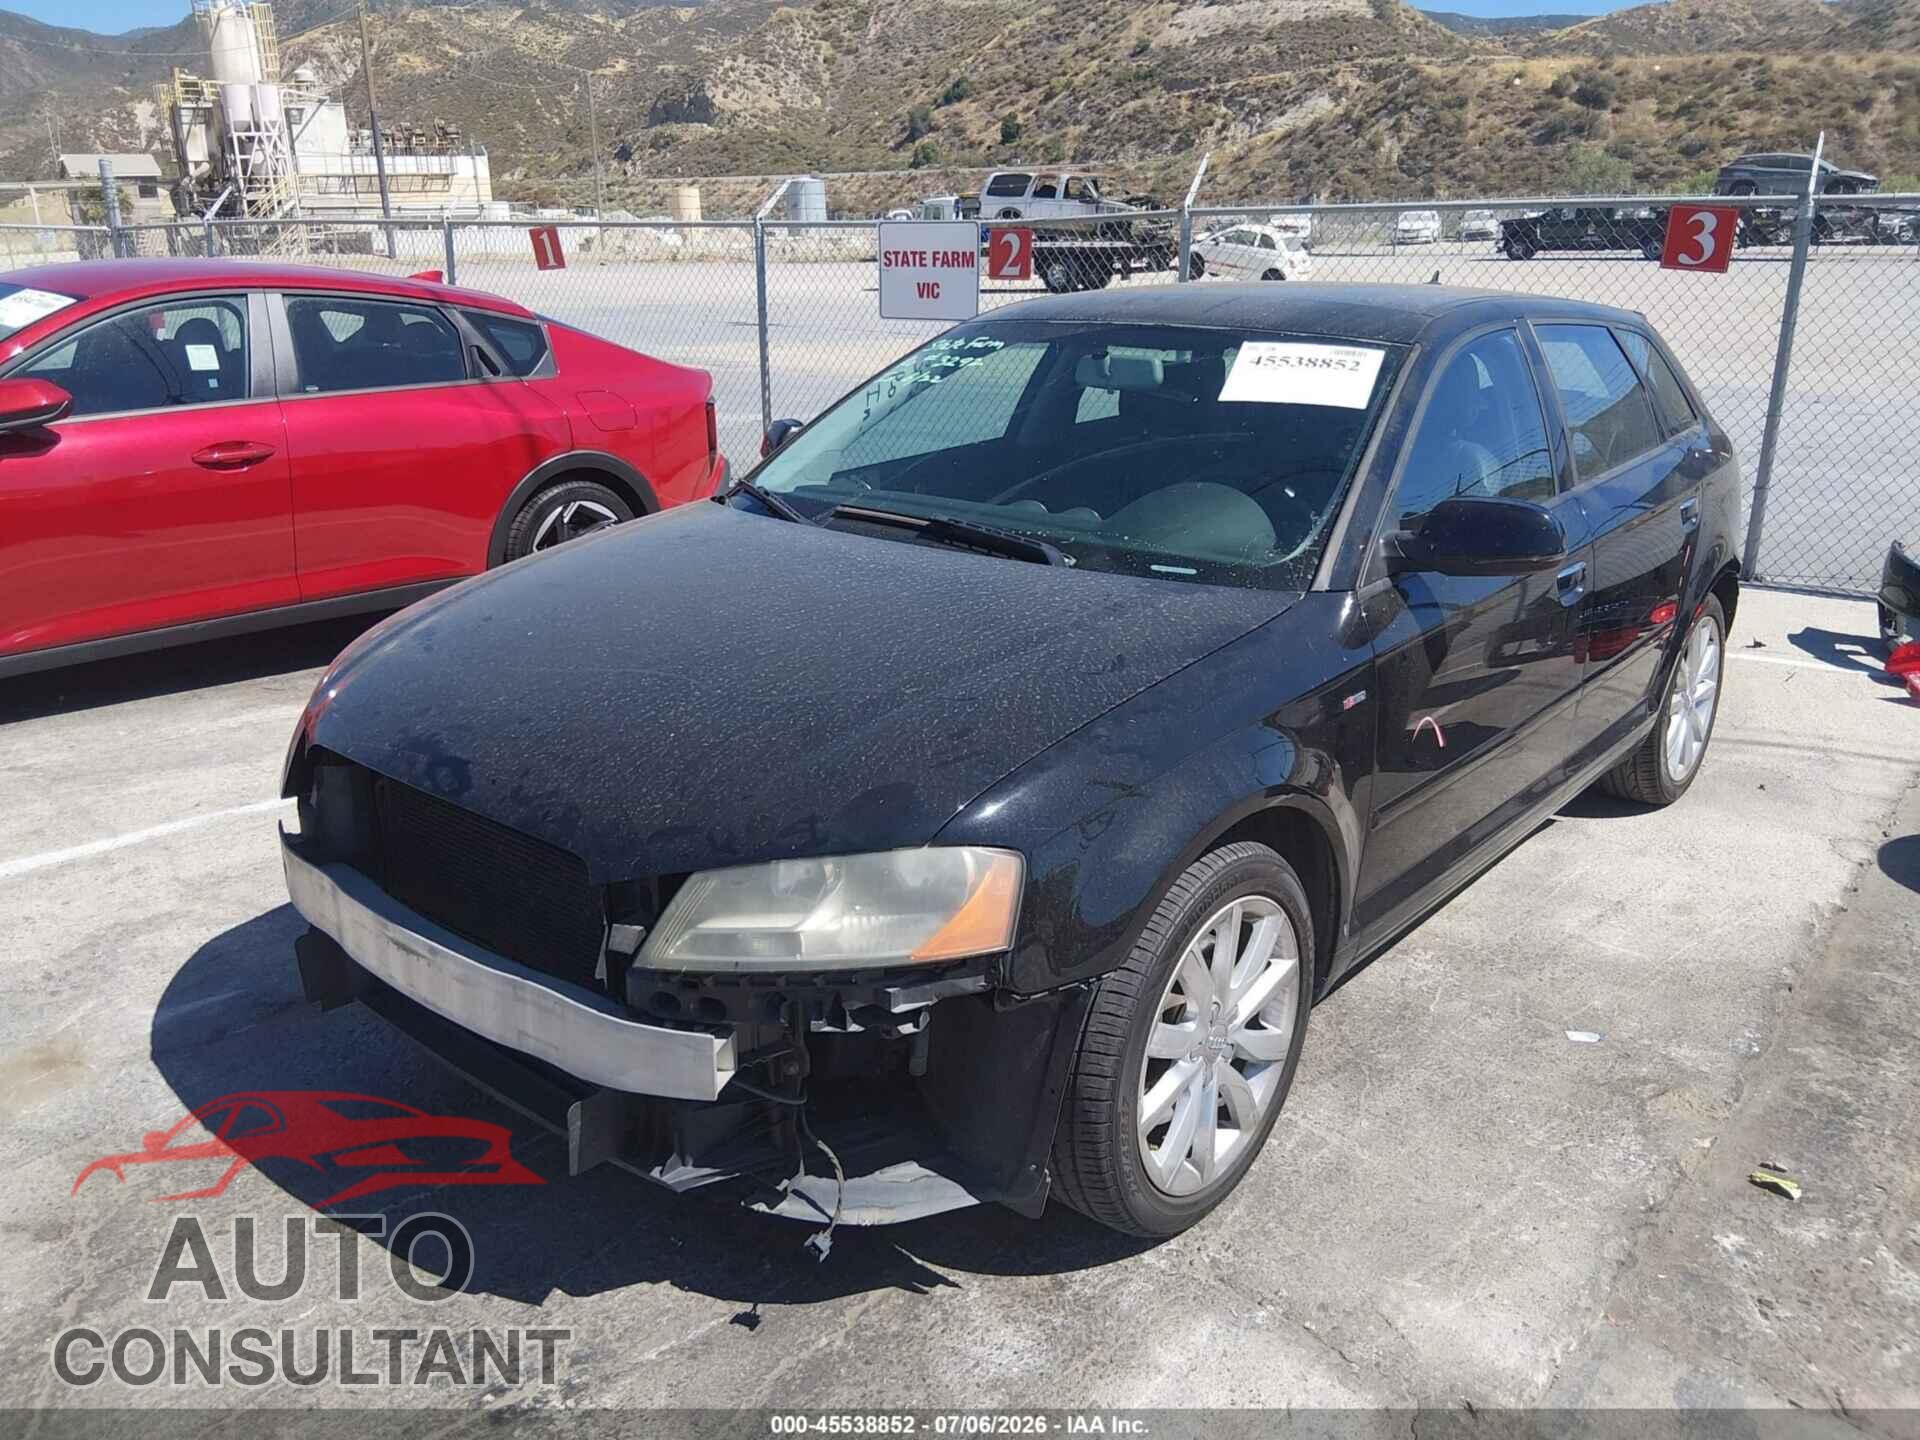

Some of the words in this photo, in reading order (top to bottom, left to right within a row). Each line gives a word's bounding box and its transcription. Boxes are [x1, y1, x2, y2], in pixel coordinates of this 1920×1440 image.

[539, 231, 558, 266] 1
[1678, 211, 1718, 265] 3
[883, 250, 928, 268] STATE
[932, 251, 976, 269] FARM
[999, 232, 1022, 276] 2
[916, 282, 940, 299] VIC
[1249, 354, 1361, 373] 45538852
